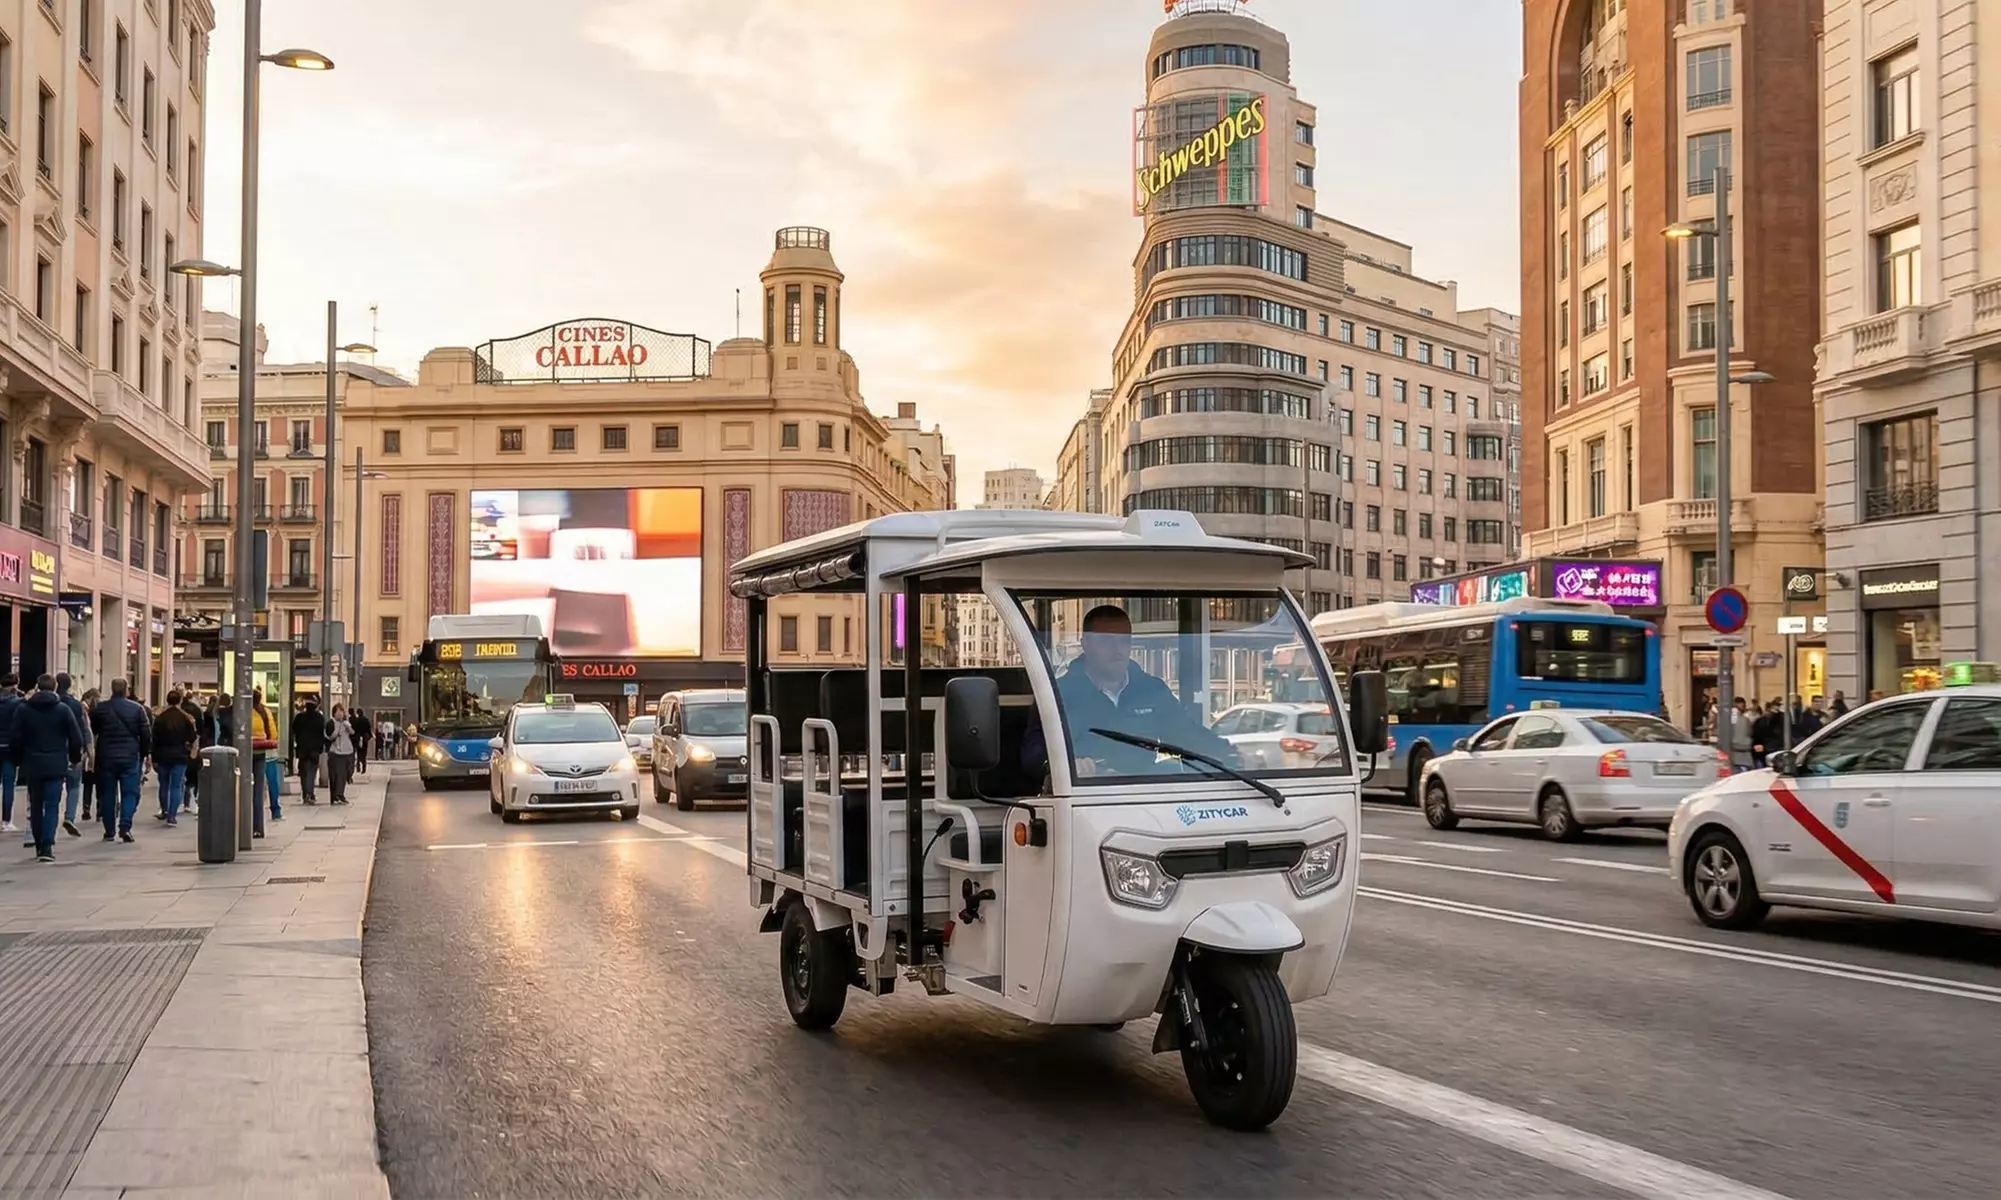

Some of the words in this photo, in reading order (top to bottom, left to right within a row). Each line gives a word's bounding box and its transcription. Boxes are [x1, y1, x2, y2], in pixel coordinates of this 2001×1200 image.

[1136, 99, 1265, 212] Schweppes
[558, 326, 625, 343] CINES
[535, 344, 648, 368] CALLAO
[562, 664, 577, 676] ES
[582, 663, 636, 676] CALLAO
[1198, 807, 1249, 820] ZITYCAR
